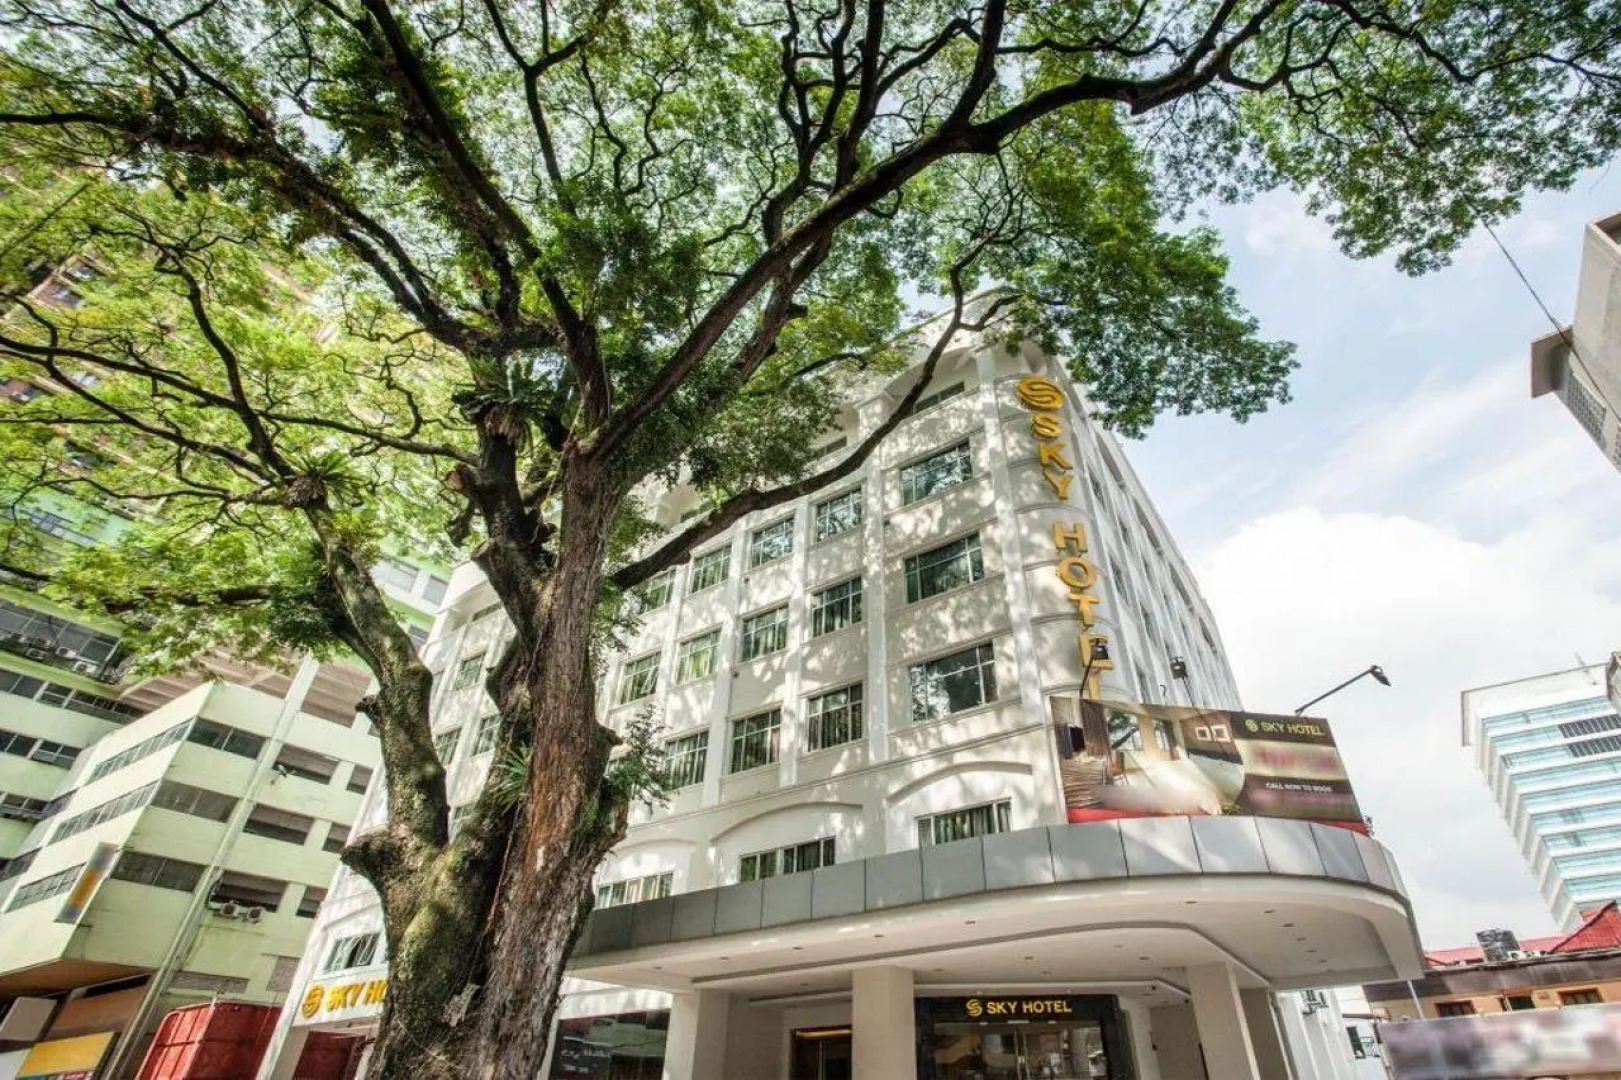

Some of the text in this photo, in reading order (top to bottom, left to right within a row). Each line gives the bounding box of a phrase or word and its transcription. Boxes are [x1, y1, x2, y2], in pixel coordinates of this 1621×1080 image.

[1031, 412, 1074, 501] SKY
[1260, 721, 1326, 737] SKY HOTEL
[326, 981, 367, 1012] SKY
[987, 1001, 1072, 1014] SKY HOTEL
